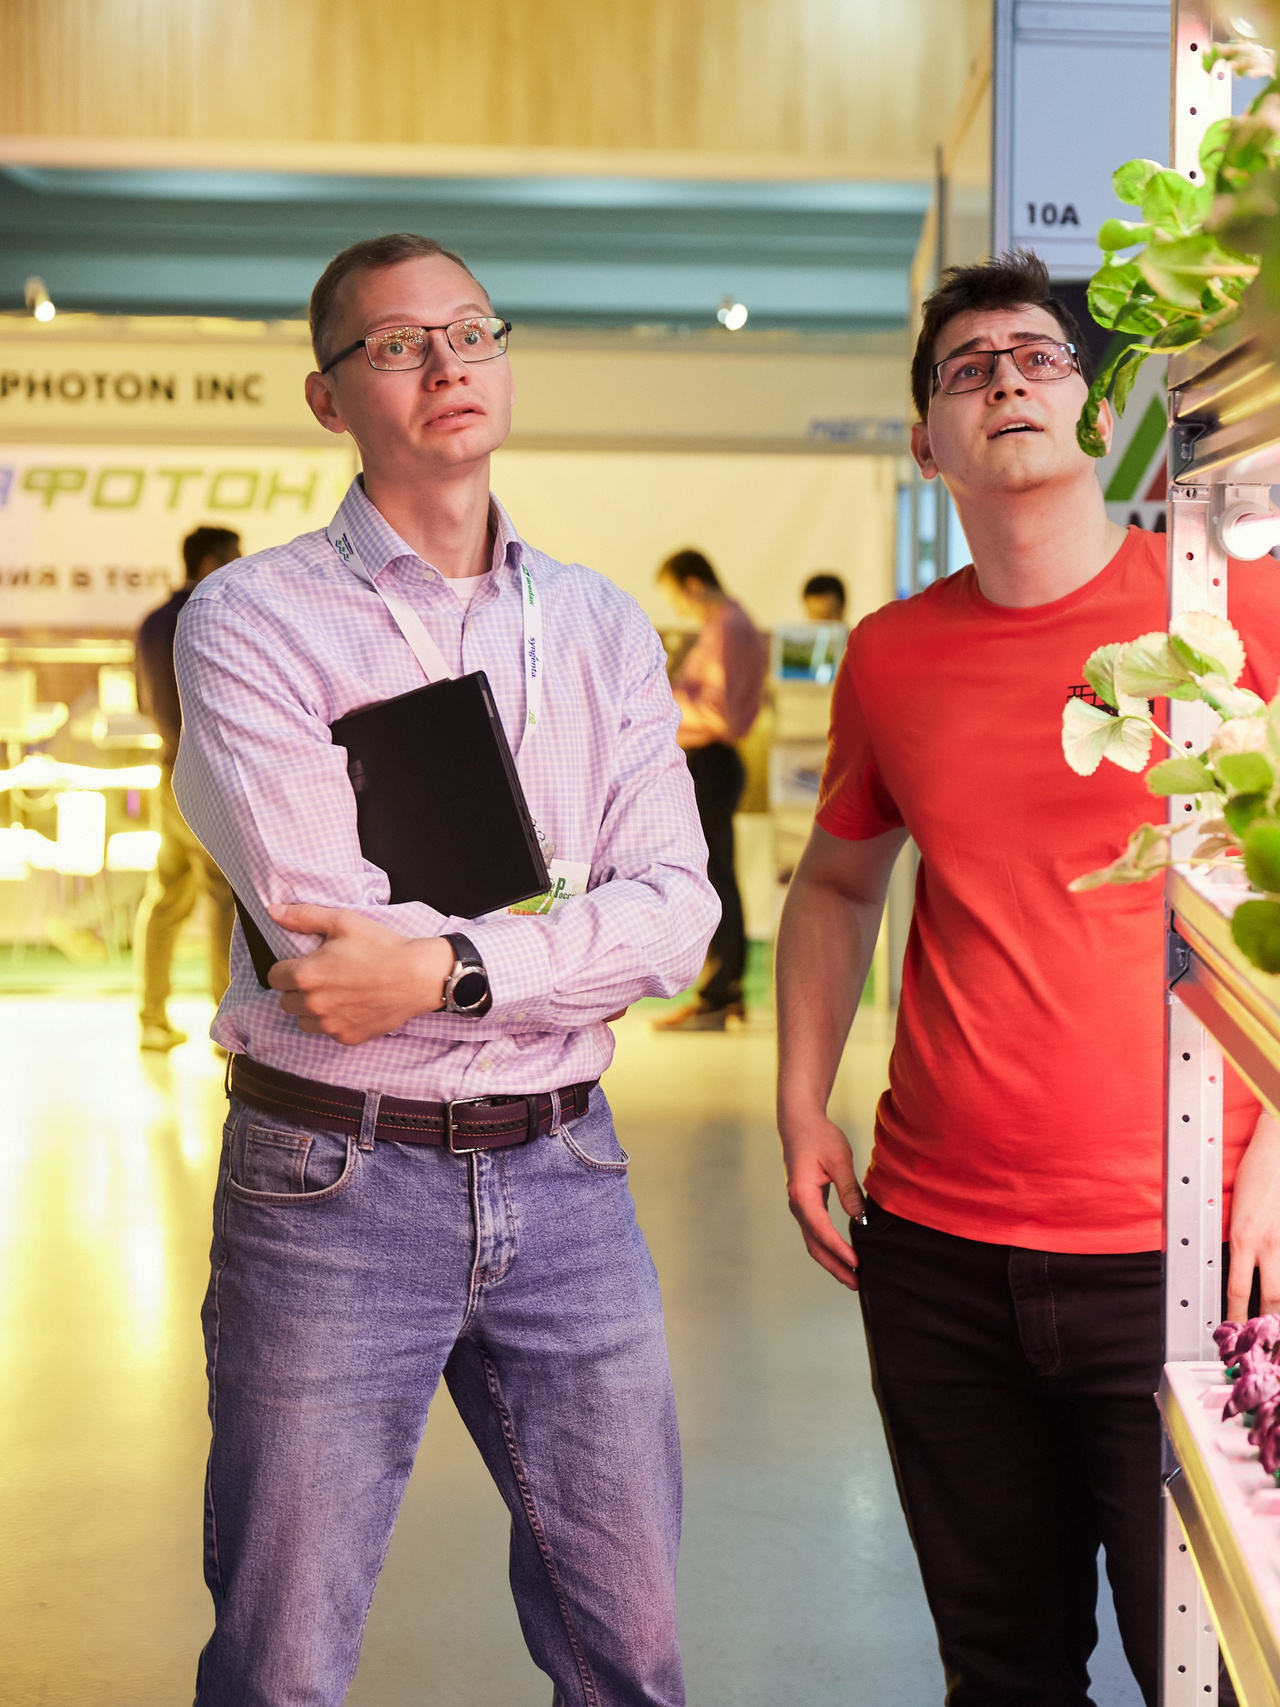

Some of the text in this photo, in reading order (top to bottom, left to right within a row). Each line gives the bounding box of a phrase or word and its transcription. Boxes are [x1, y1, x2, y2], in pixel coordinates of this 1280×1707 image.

[1026, 202, 1080, 226] 10A
[0, 374, 264, 402] PHOTON INC
[0, 467, 320, 511] ФОТОН
[527, 637, 538, 679] syngenta
